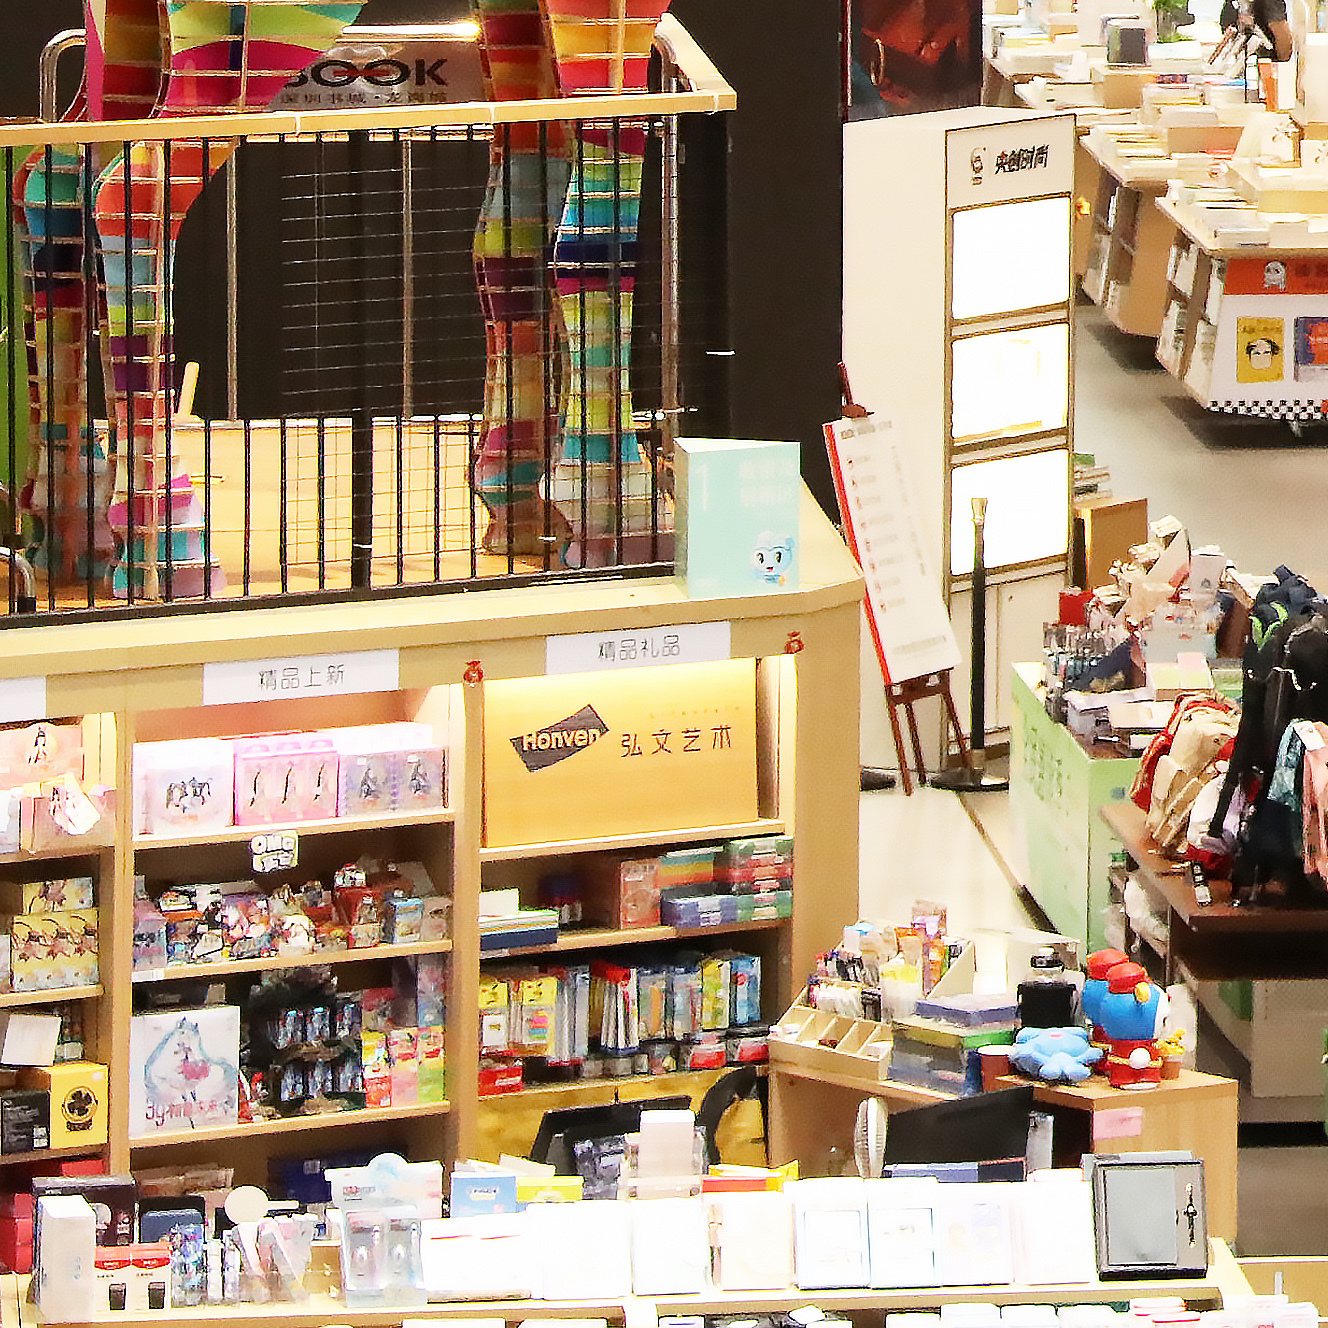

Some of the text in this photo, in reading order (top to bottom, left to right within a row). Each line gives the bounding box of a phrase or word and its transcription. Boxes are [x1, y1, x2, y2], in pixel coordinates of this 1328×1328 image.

[598, 634, 681, 662] 精品礼品
[258, 664, 346, 691] 精品上新
[522, 727, 603, 753] Honven
[621, 724, 731, 758] 弘文艺术
